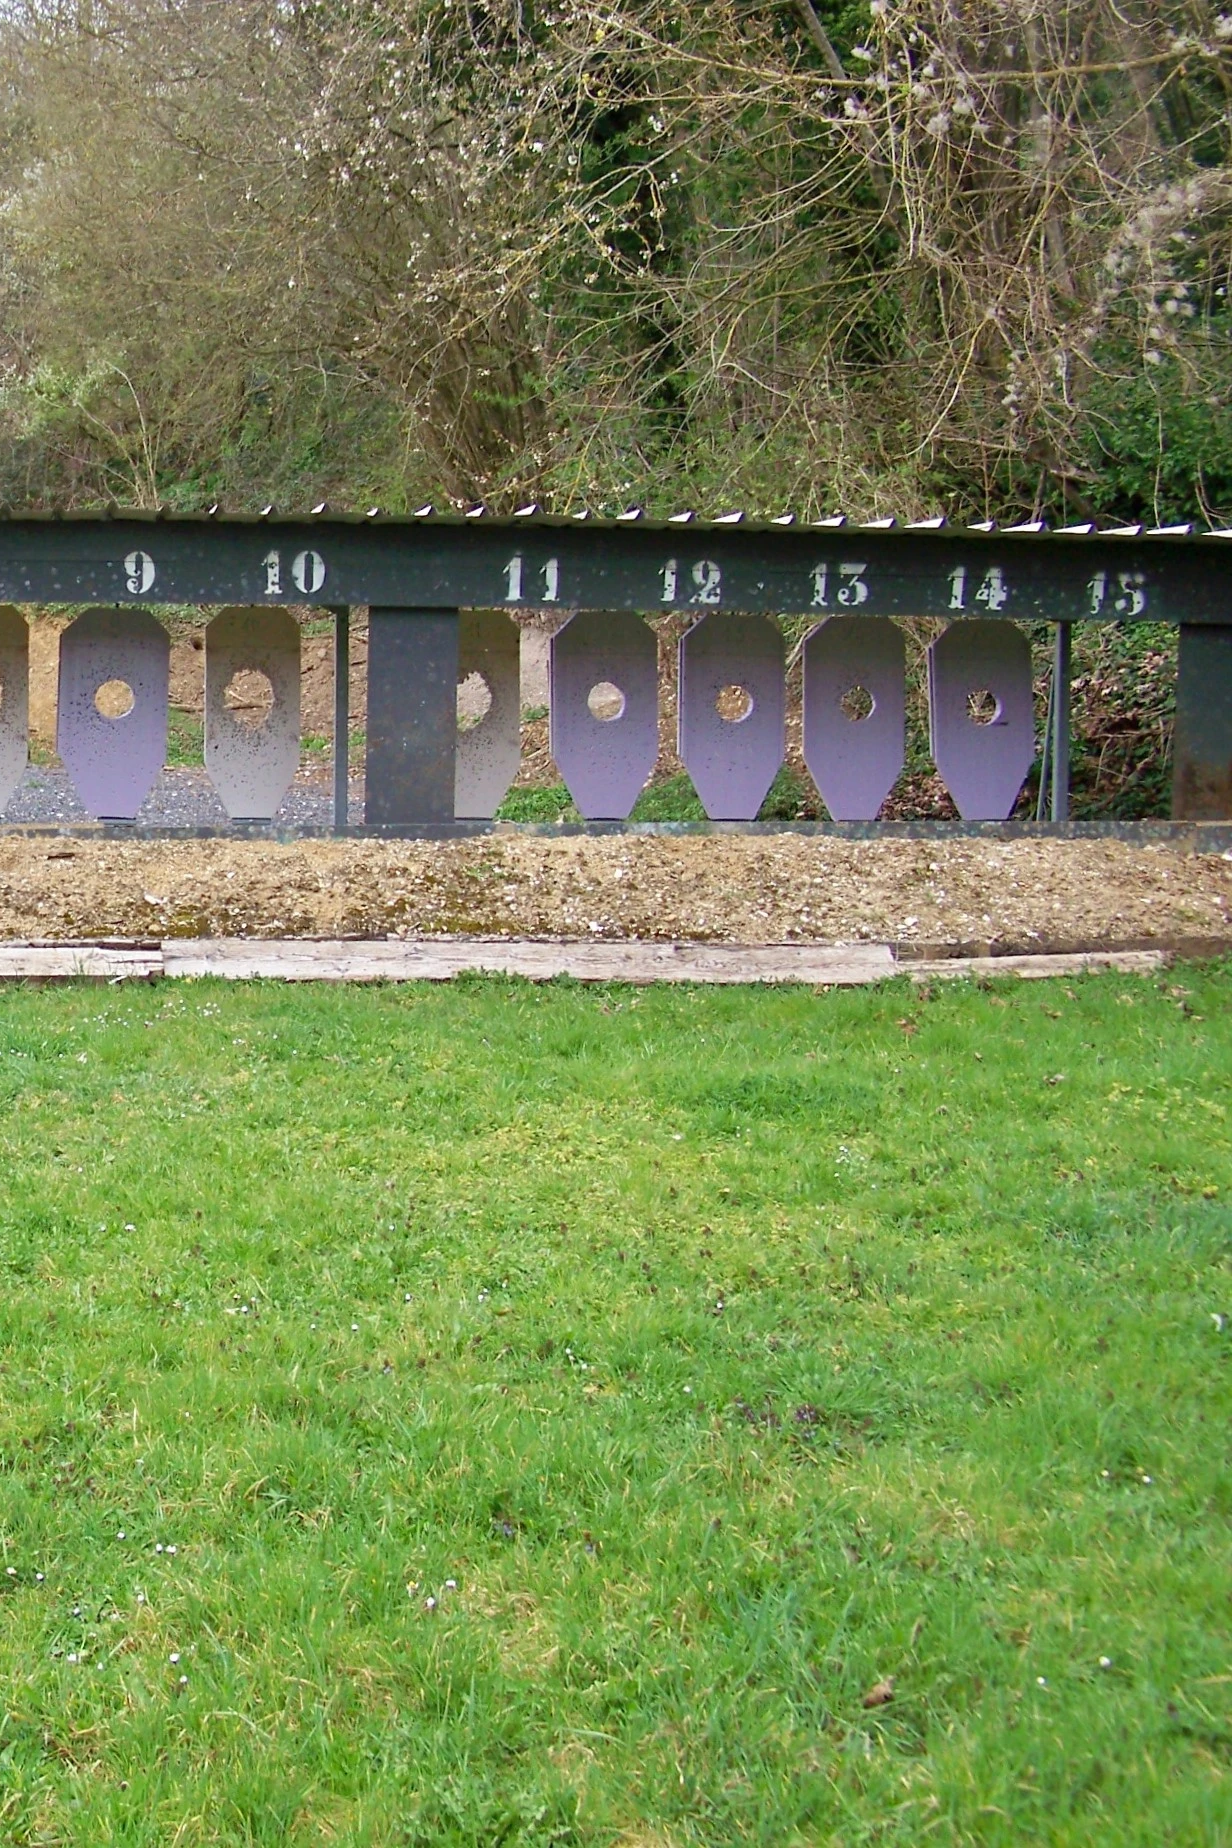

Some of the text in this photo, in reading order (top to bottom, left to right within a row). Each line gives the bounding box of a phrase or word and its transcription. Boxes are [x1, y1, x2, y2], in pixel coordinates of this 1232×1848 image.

[124, 551, 156, 594] 9
[262, 550, 326, 595] 10
[503, 557, 560, 602] 11
[658, 559, 721, 605] 12
[809, 563, 868, 606] 13
[947, 568, 1008, 610] 14
[1088, 573, 1146, 616] 15
